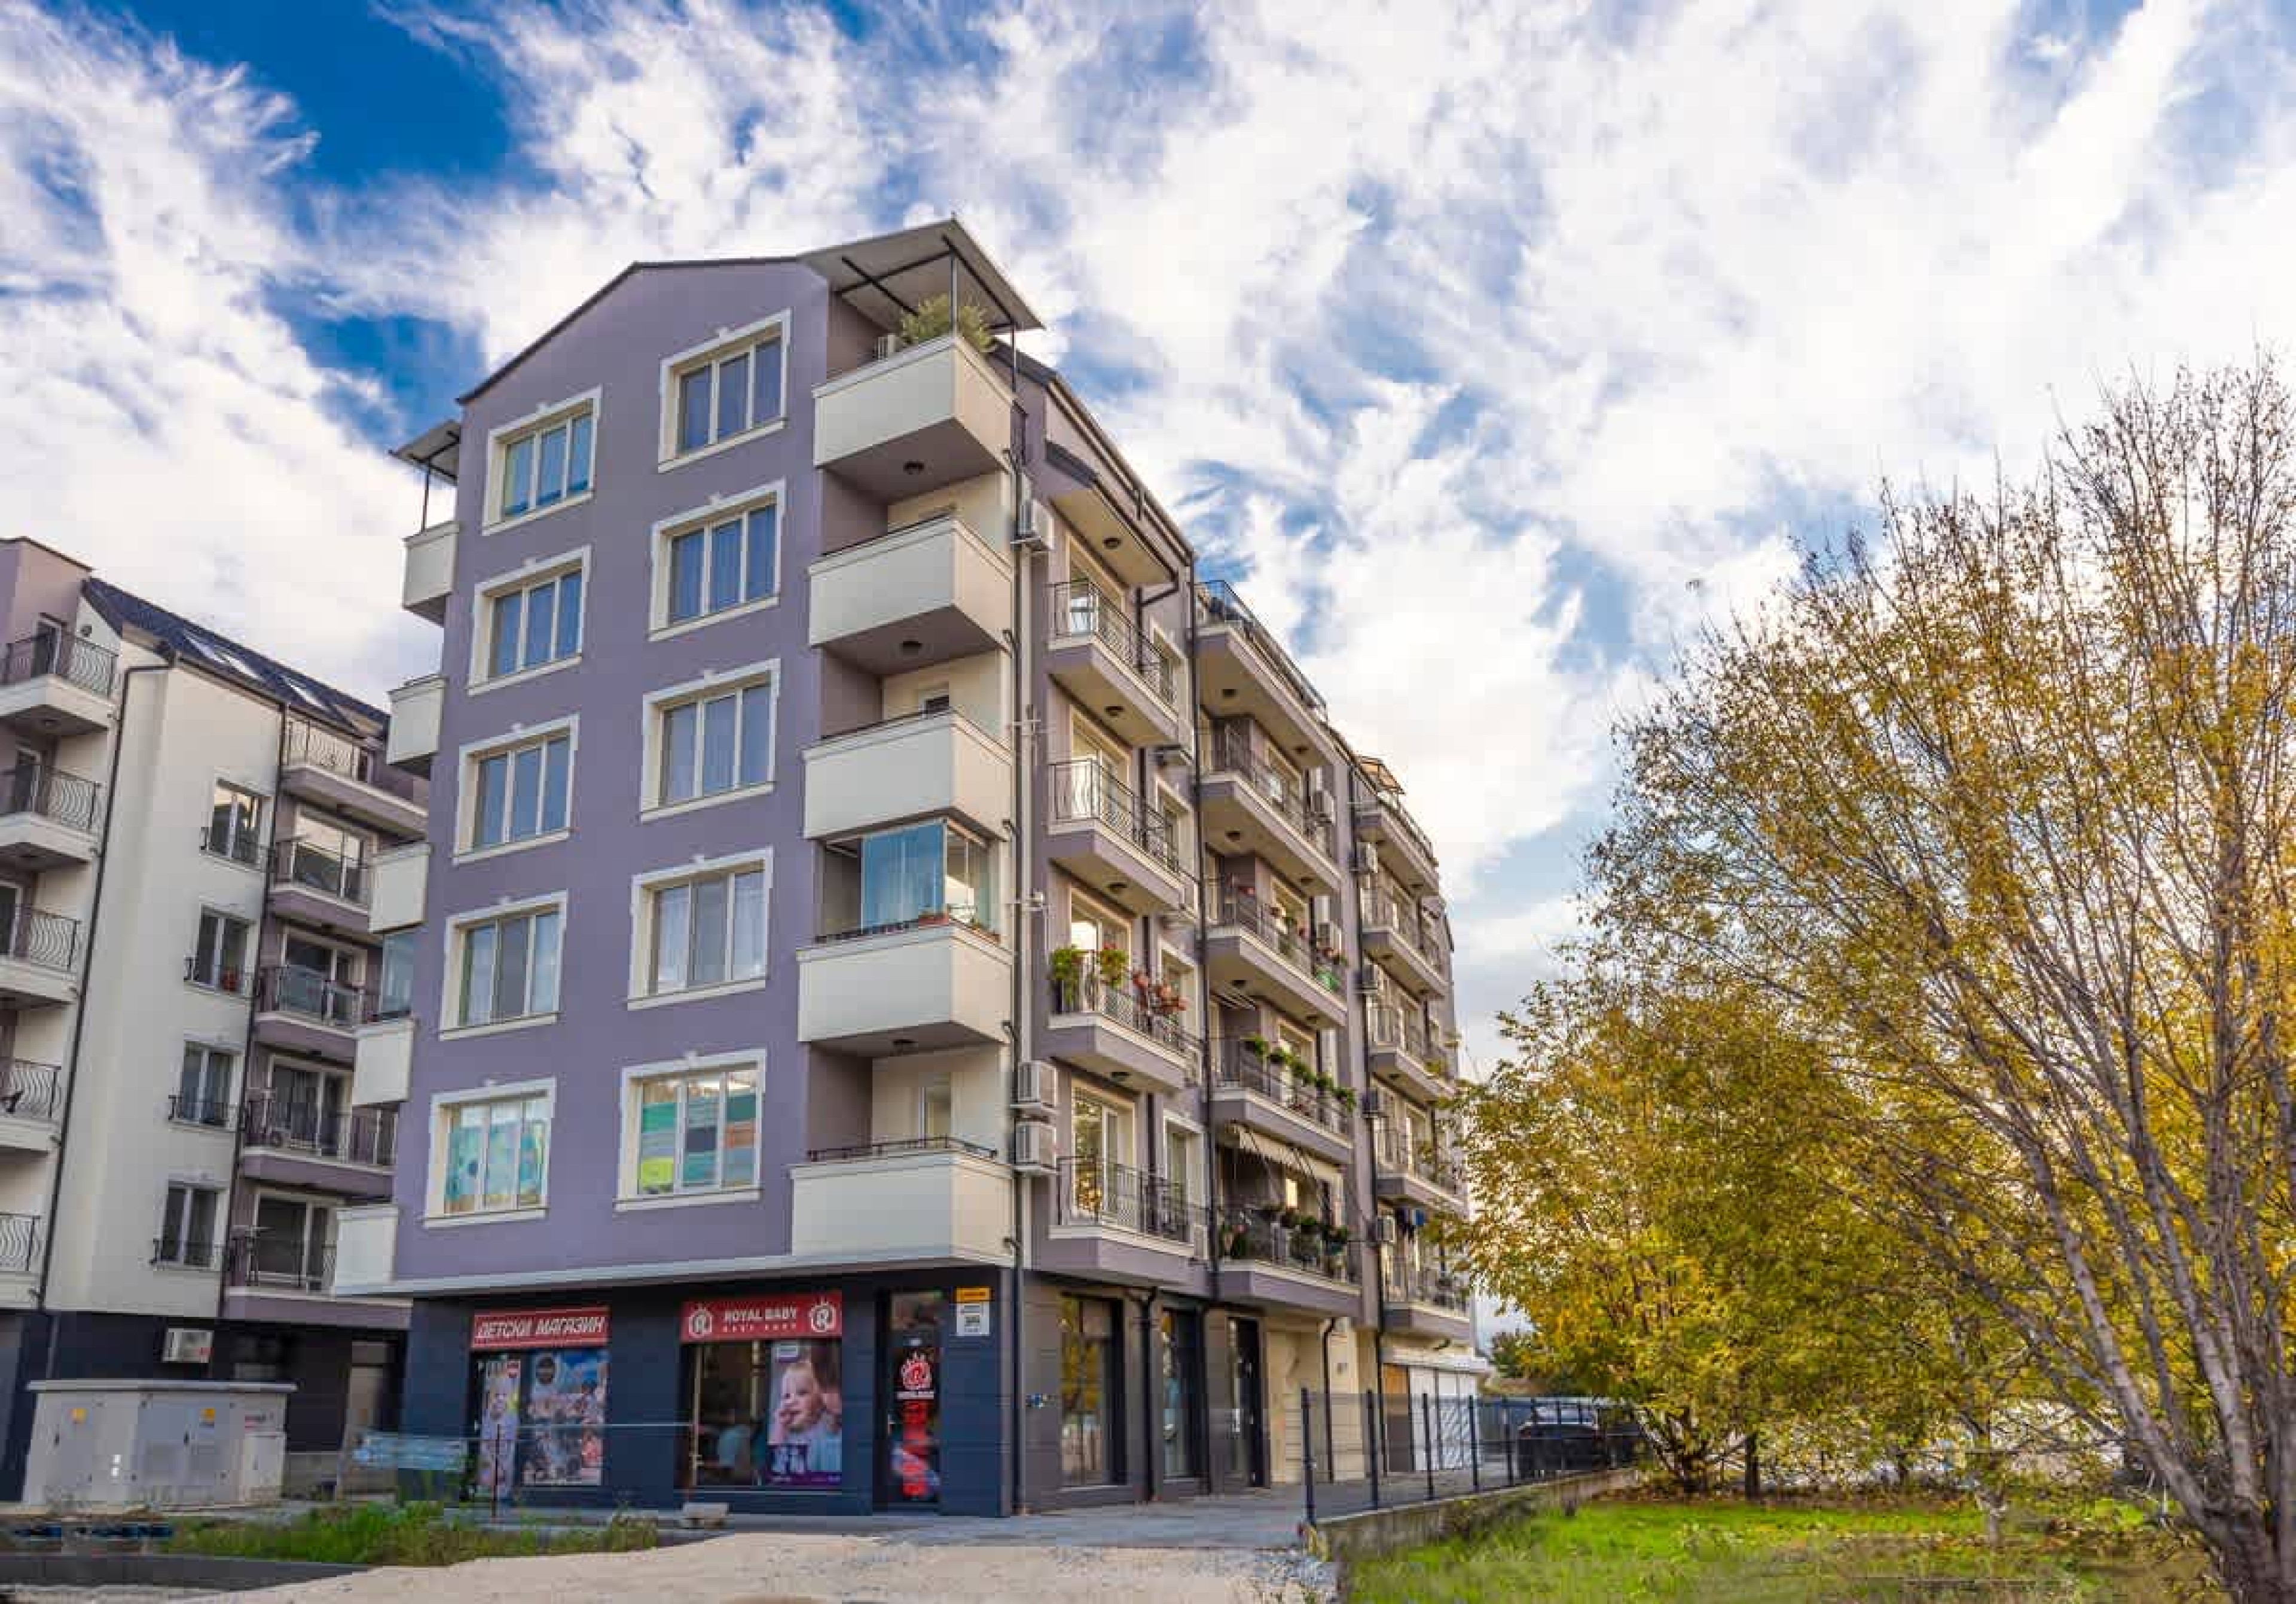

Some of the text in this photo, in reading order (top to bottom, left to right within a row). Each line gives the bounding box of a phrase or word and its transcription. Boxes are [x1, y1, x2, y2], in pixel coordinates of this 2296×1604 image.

[723, 1306, 797, 1323] ROYAL BABY
[477, 1316, 605, 1338] ДЕТСКИ МАГАЗИН
